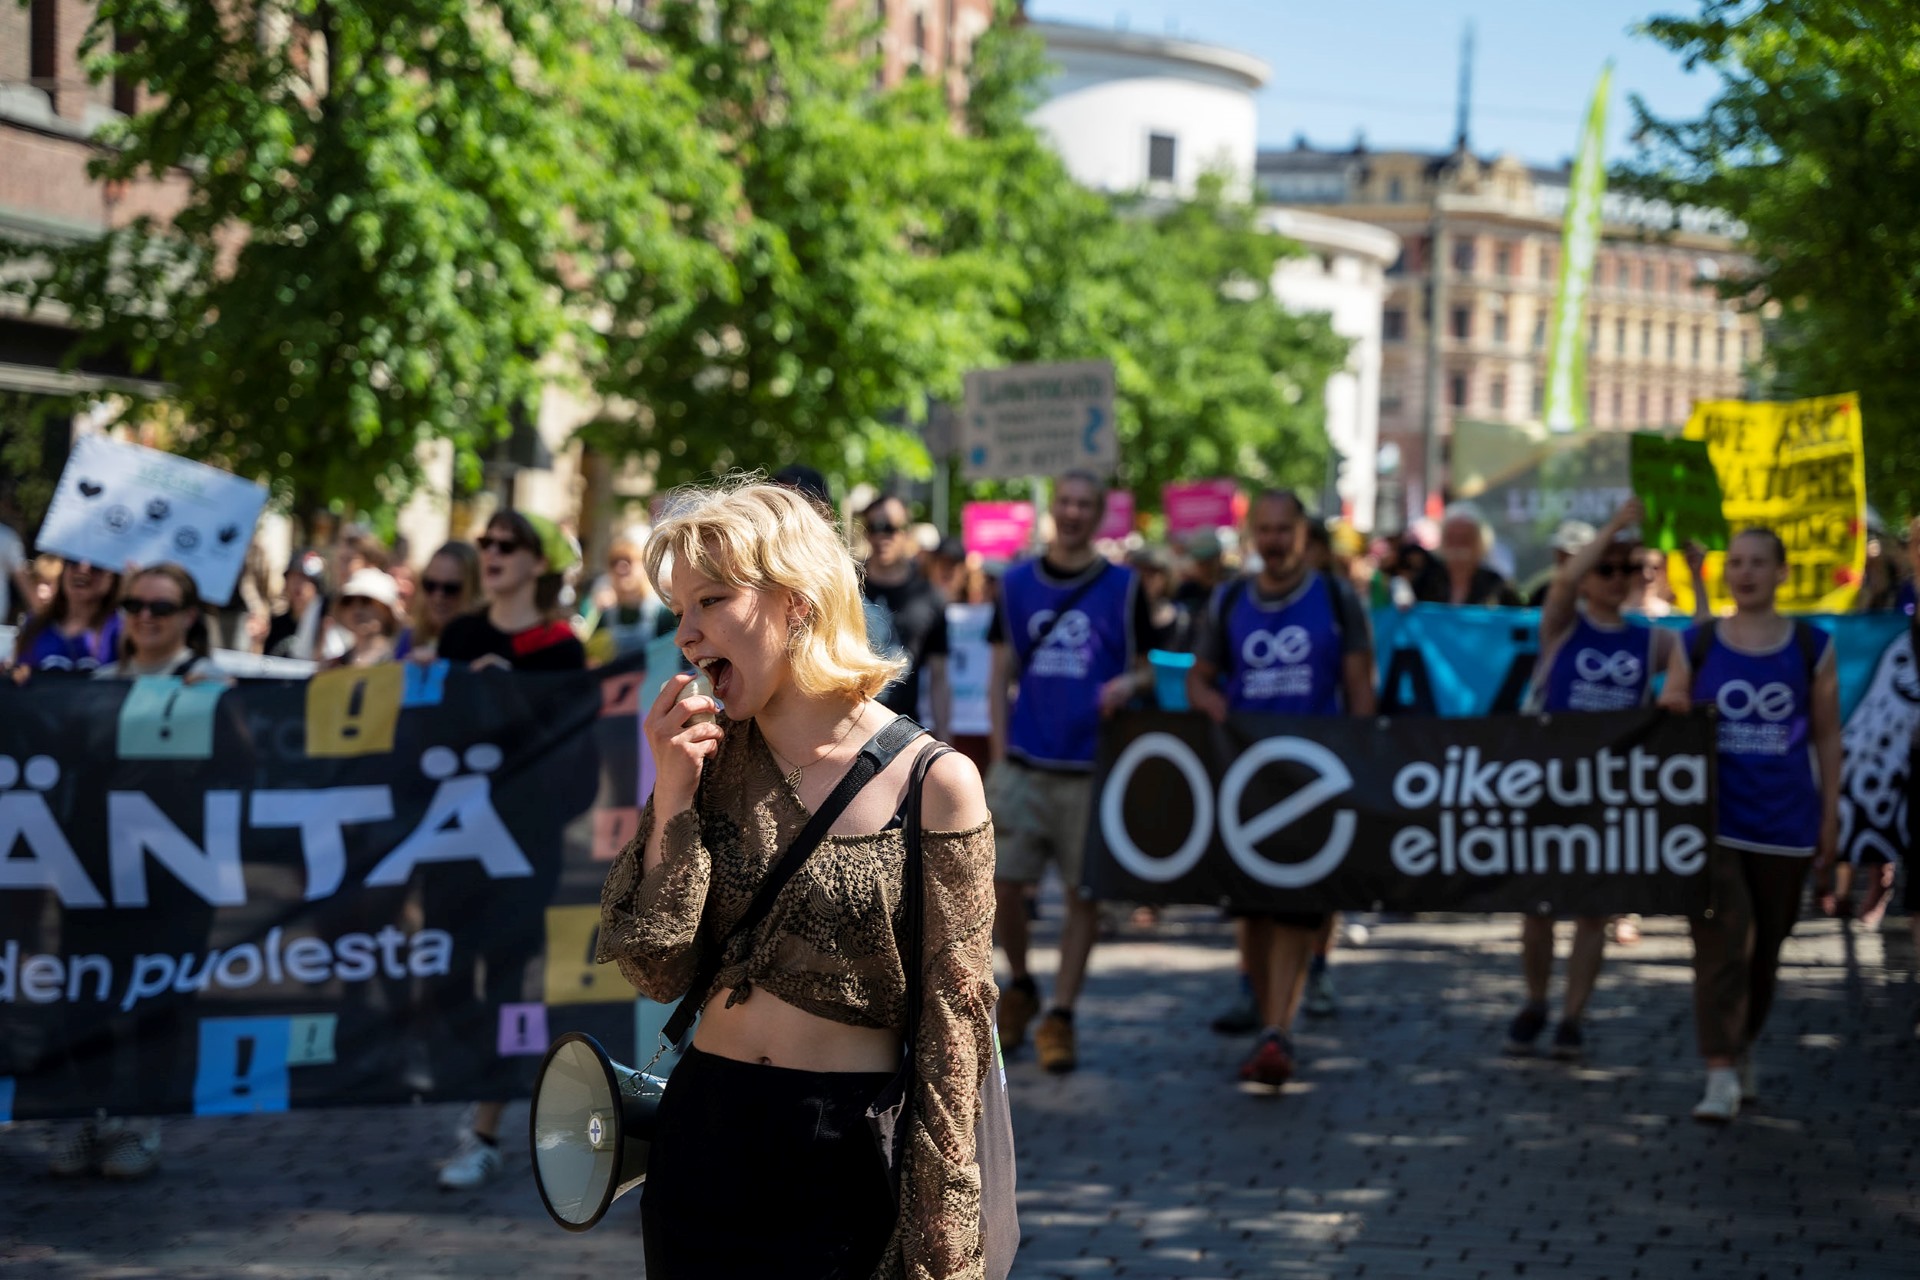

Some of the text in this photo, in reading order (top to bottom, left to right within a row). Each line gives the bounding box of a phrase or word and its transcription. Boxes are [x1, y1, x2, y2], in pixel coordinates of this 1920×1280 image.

[1393, 745, 1708, 809] oikeutta
[0, 743, 534, 908] ÄNTÄ
[1391, 808, 1707, 876] eläimille
[121, 924, 454, 1012] puolesta
